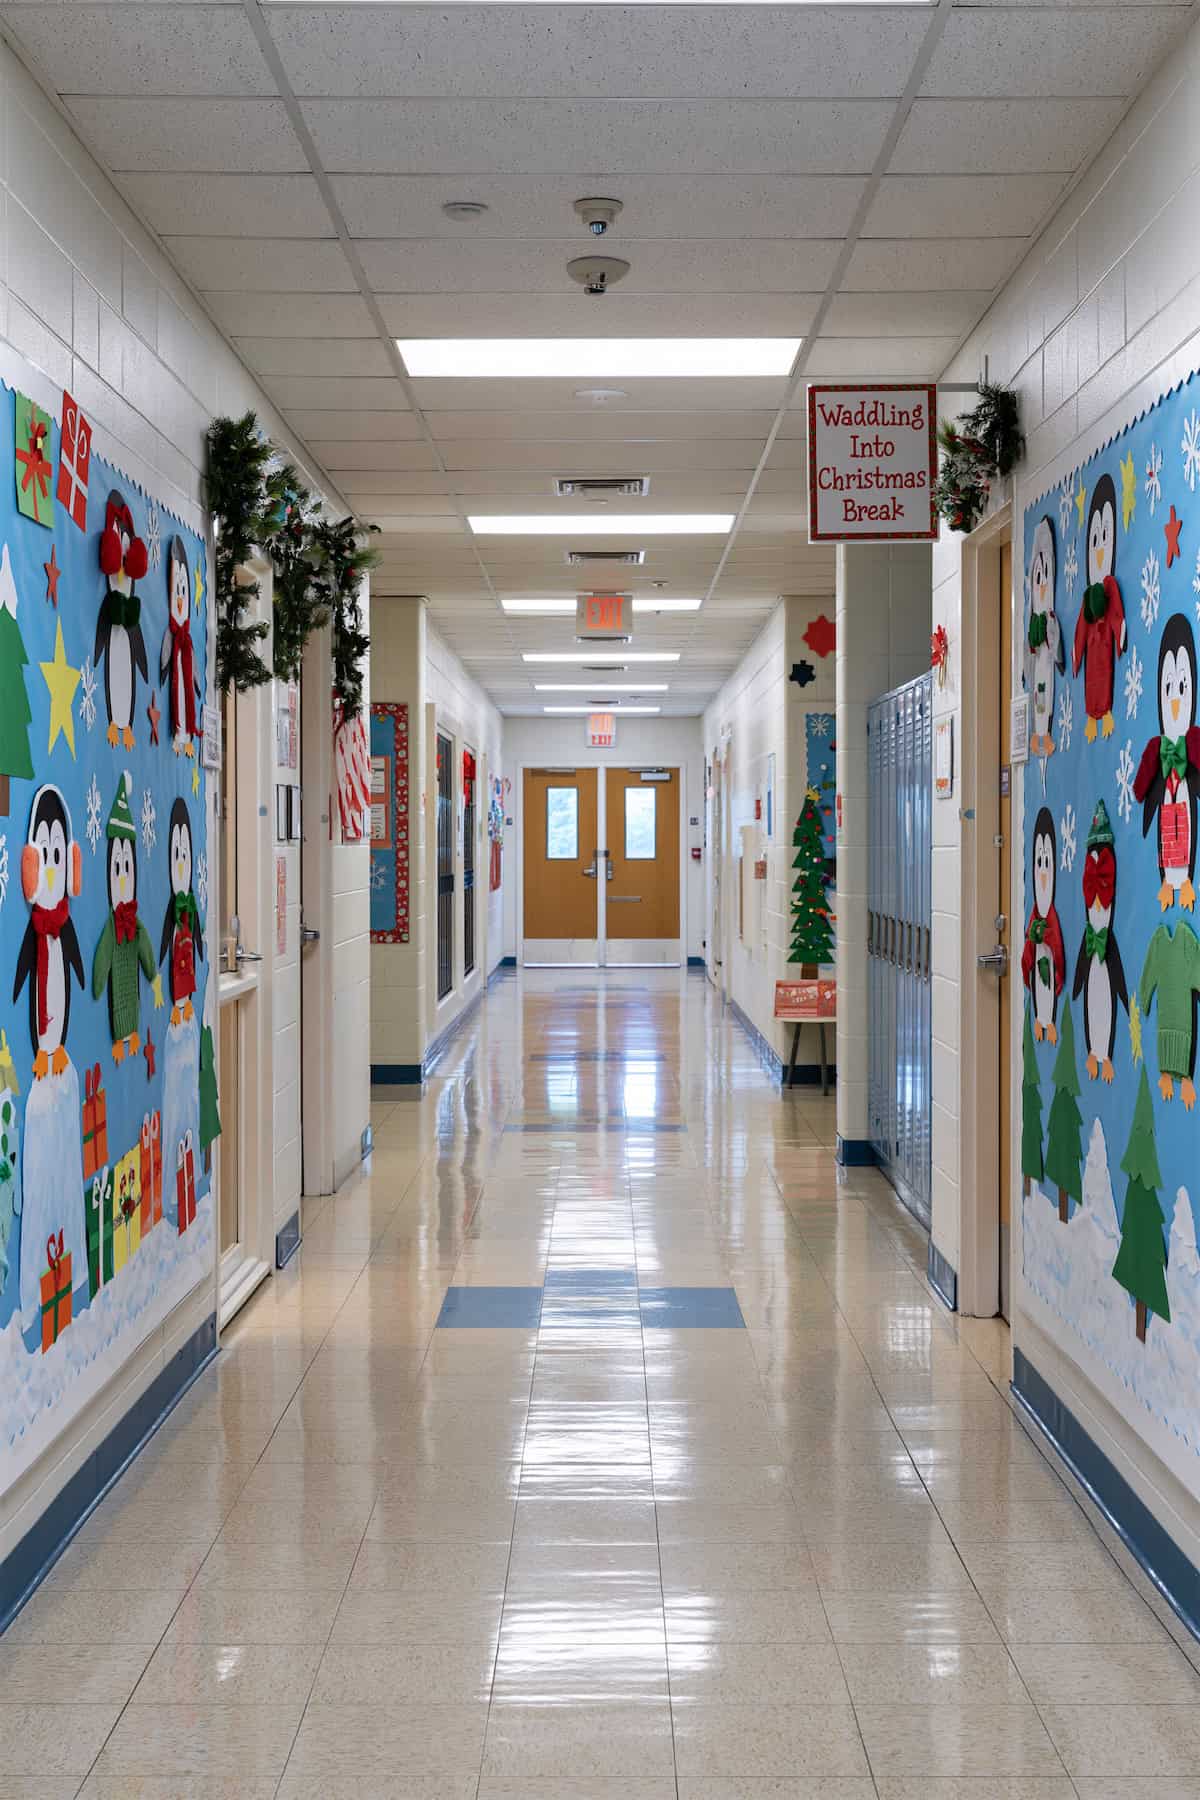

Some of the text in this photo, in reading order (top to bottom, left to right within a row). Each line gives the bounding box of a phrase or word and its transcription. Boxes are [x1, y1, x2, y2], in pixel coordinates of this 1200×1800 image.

[817, 400, 925, 431] Waddling
[849, 434, 895, 458] Into
[818, 466, 927, 491] Christmas
[842, 496, 905, 522] Break
[587, 597, 624, 629] EXIT
[591, 735, 611, 745] EXIT
